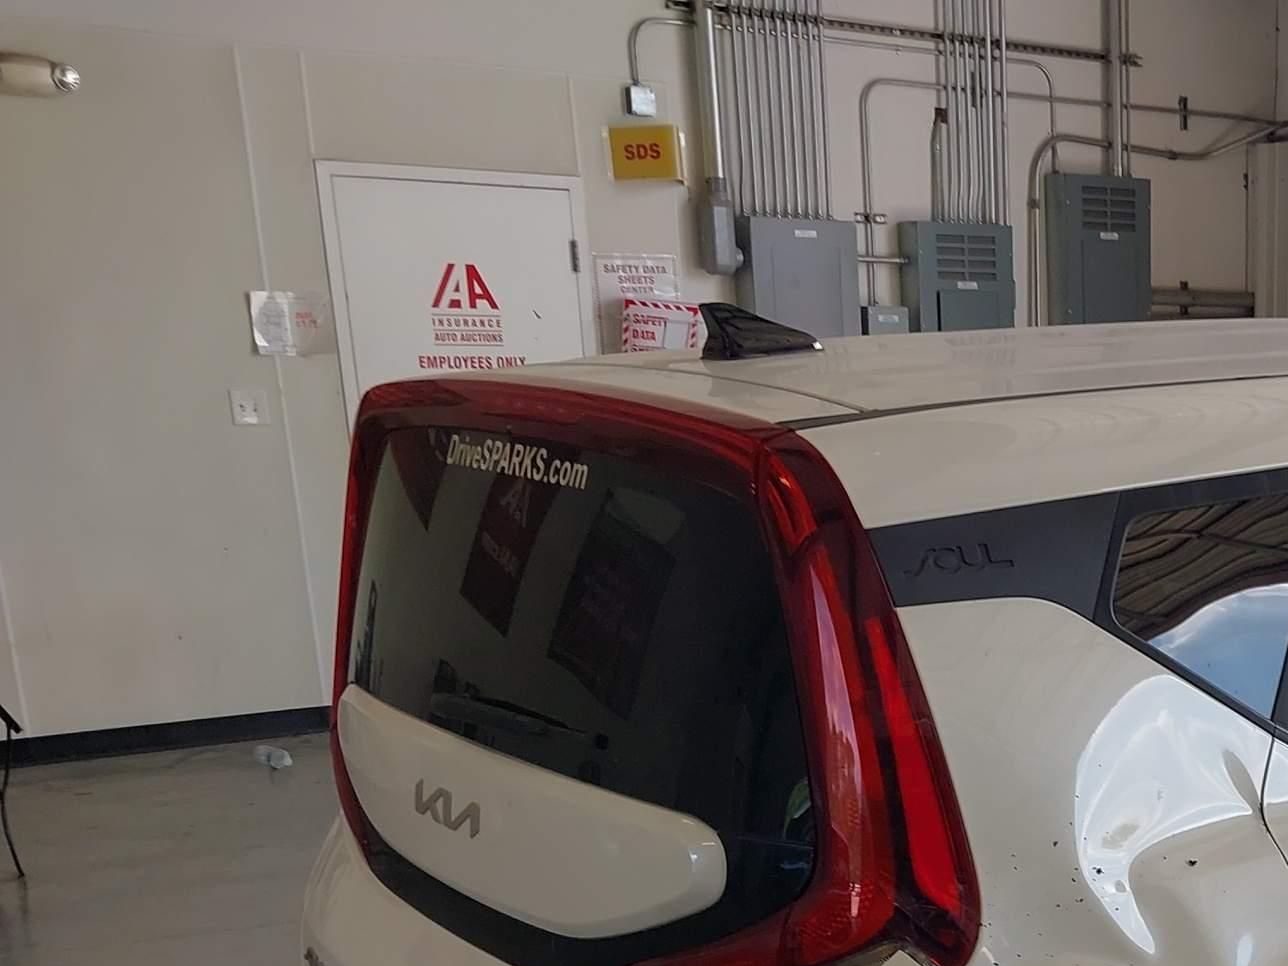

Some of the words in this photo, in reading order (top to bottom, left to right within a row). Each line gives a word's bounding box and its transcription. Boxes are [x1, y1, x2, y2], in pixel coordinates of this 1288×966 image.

[624, 143, 661, 160] SDS
[603, 264, 639, 273] SAFETY
[642, 265, 667, 274] DATA
[618, 275, 655, 285] SHEETS
[432, 318, 502, 328] INSURANCE
[434, 333, 457, 342] AUTO
[460, 333, 503, 343] AUCTIONS
[632, 329, 656, 341] DATA
[419, 355, 492, 369] EMPLOYEES
[497, 356, 526, 369] ONLY
[447, 434, 589, 490] DriveSPARKS.com
